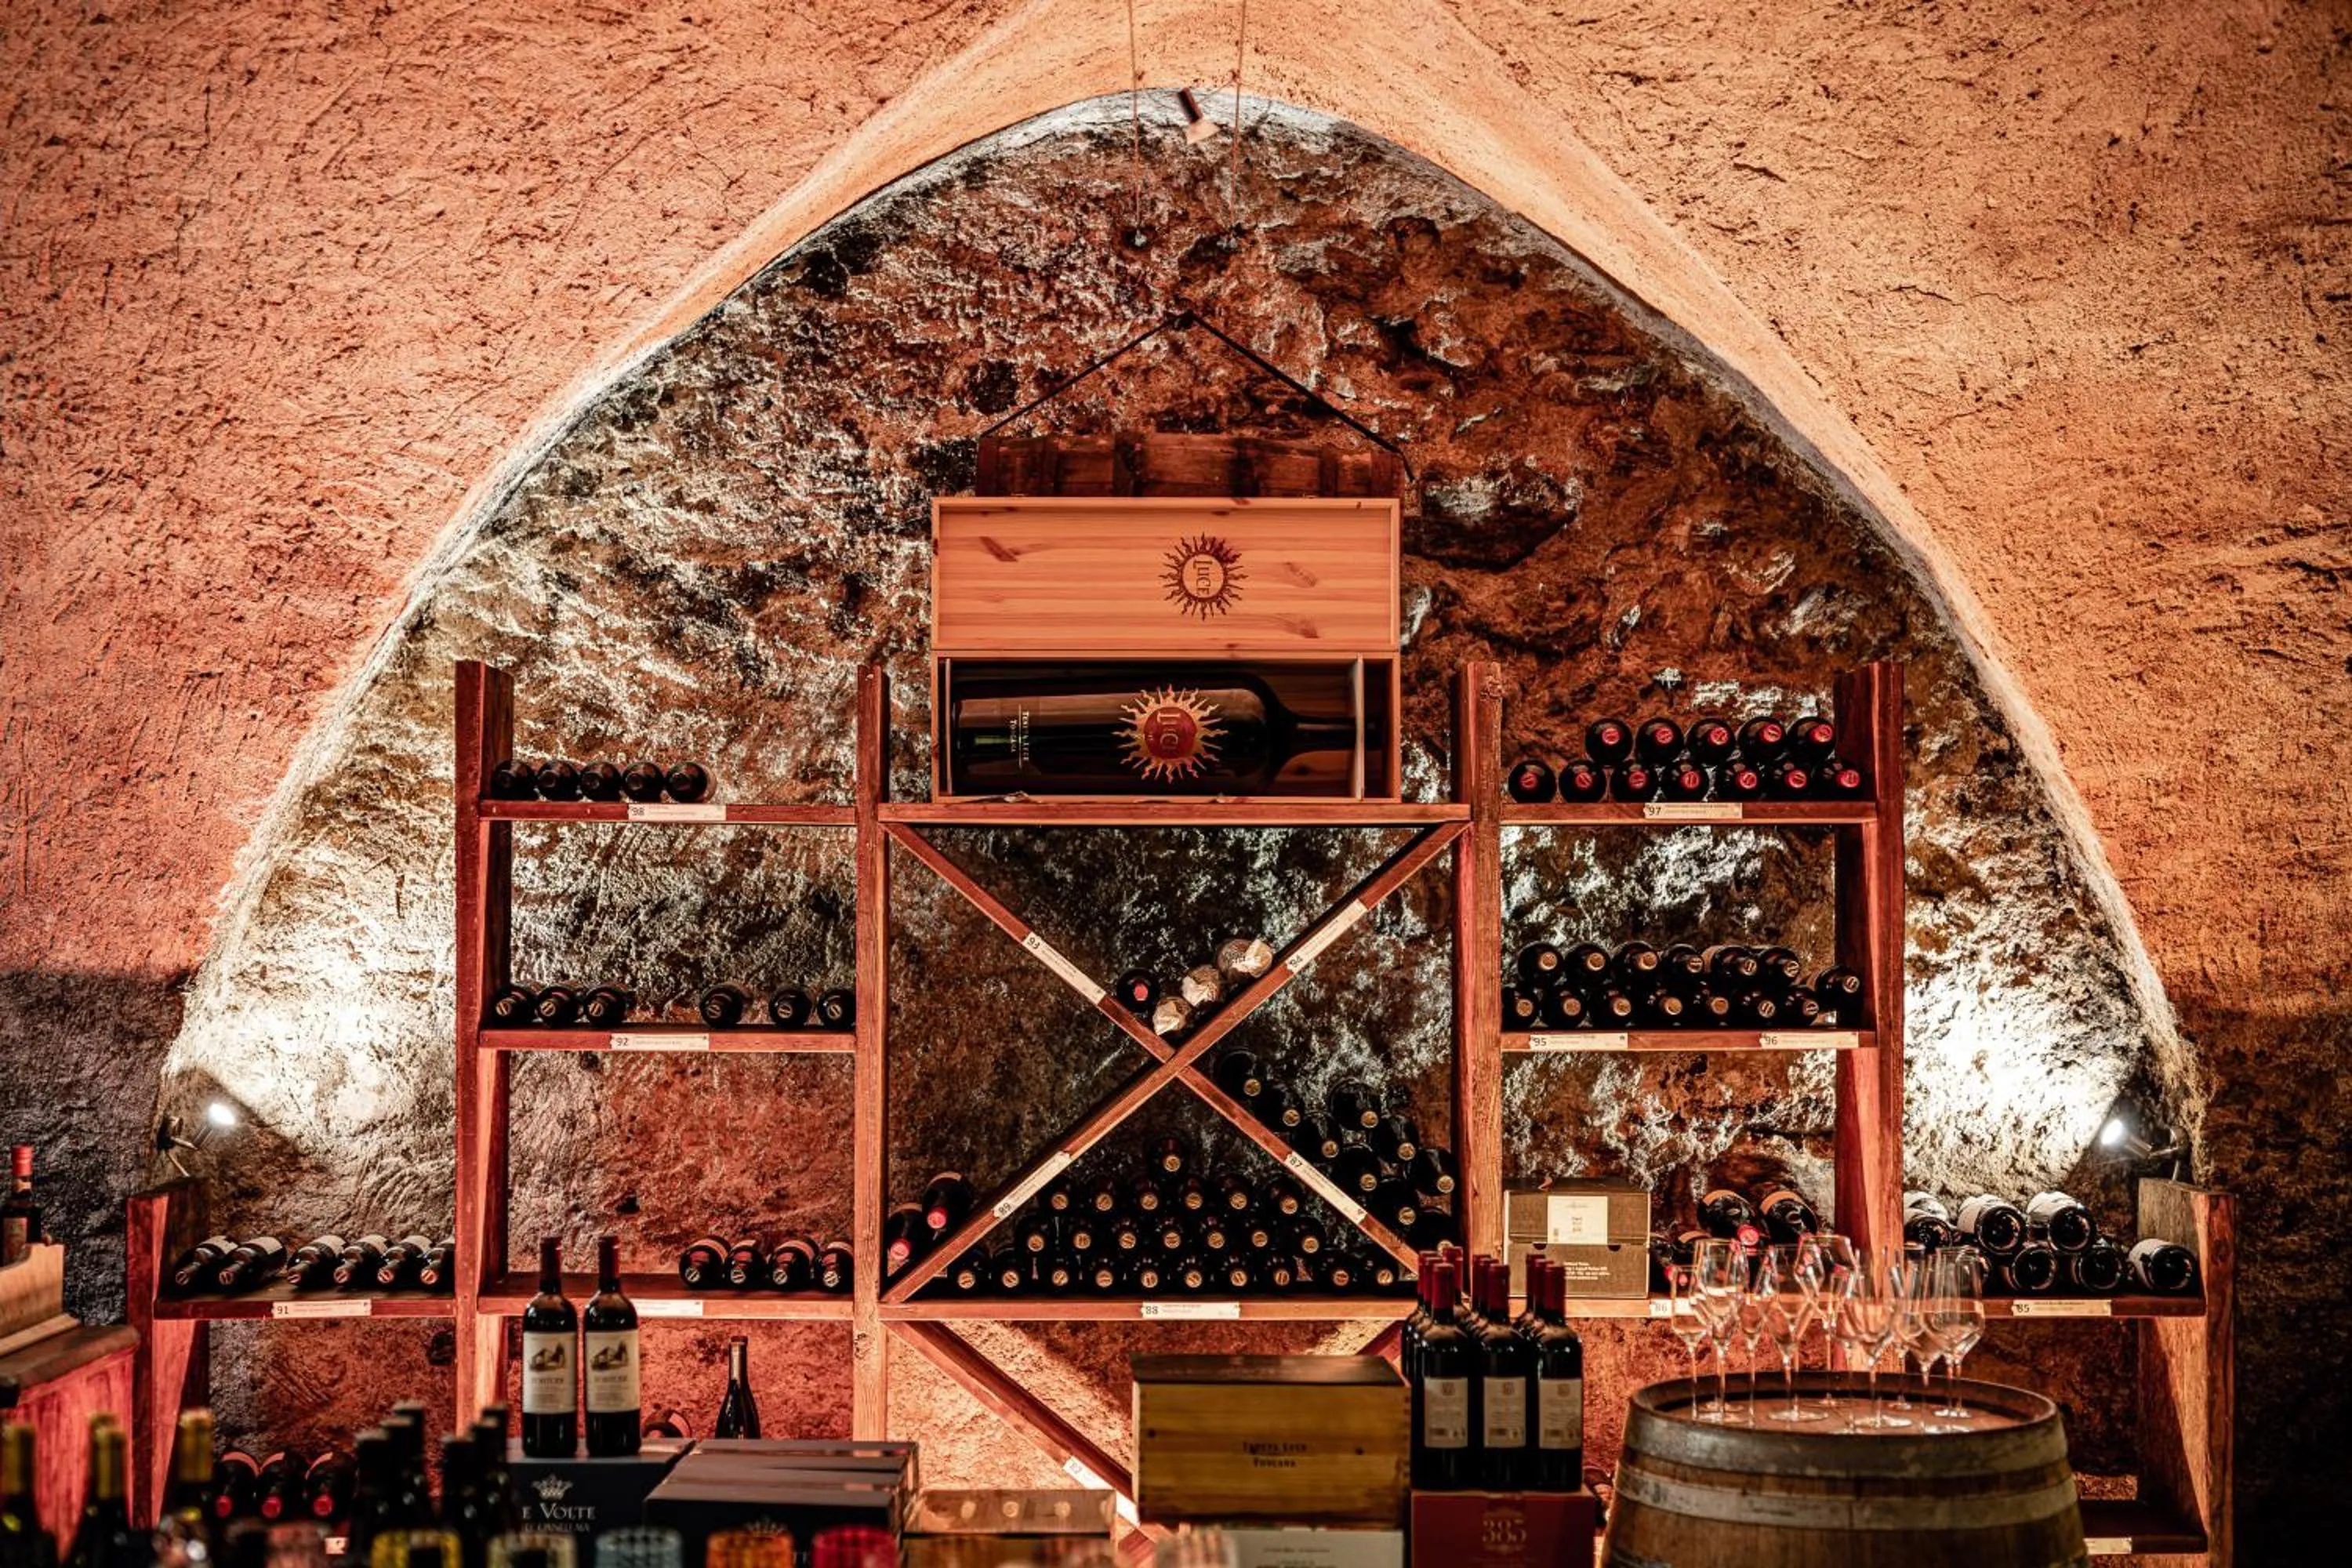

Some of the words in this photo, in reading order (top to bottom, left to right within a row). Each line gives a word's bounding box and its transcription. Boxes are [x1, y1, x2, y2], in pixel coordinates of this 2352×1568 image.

[1192, 560, 1213, 596] LUCE
[1648, 807, 1661, 816] 97
[616, 1037, 629, 1047] 92
[1534, 1037, 1547, 1047] 95
[1765, 1036, 1778, 1045] 96
[277, 1305, 289, 1315] 91
[539, 1502, 596, 1519] VOLTE
